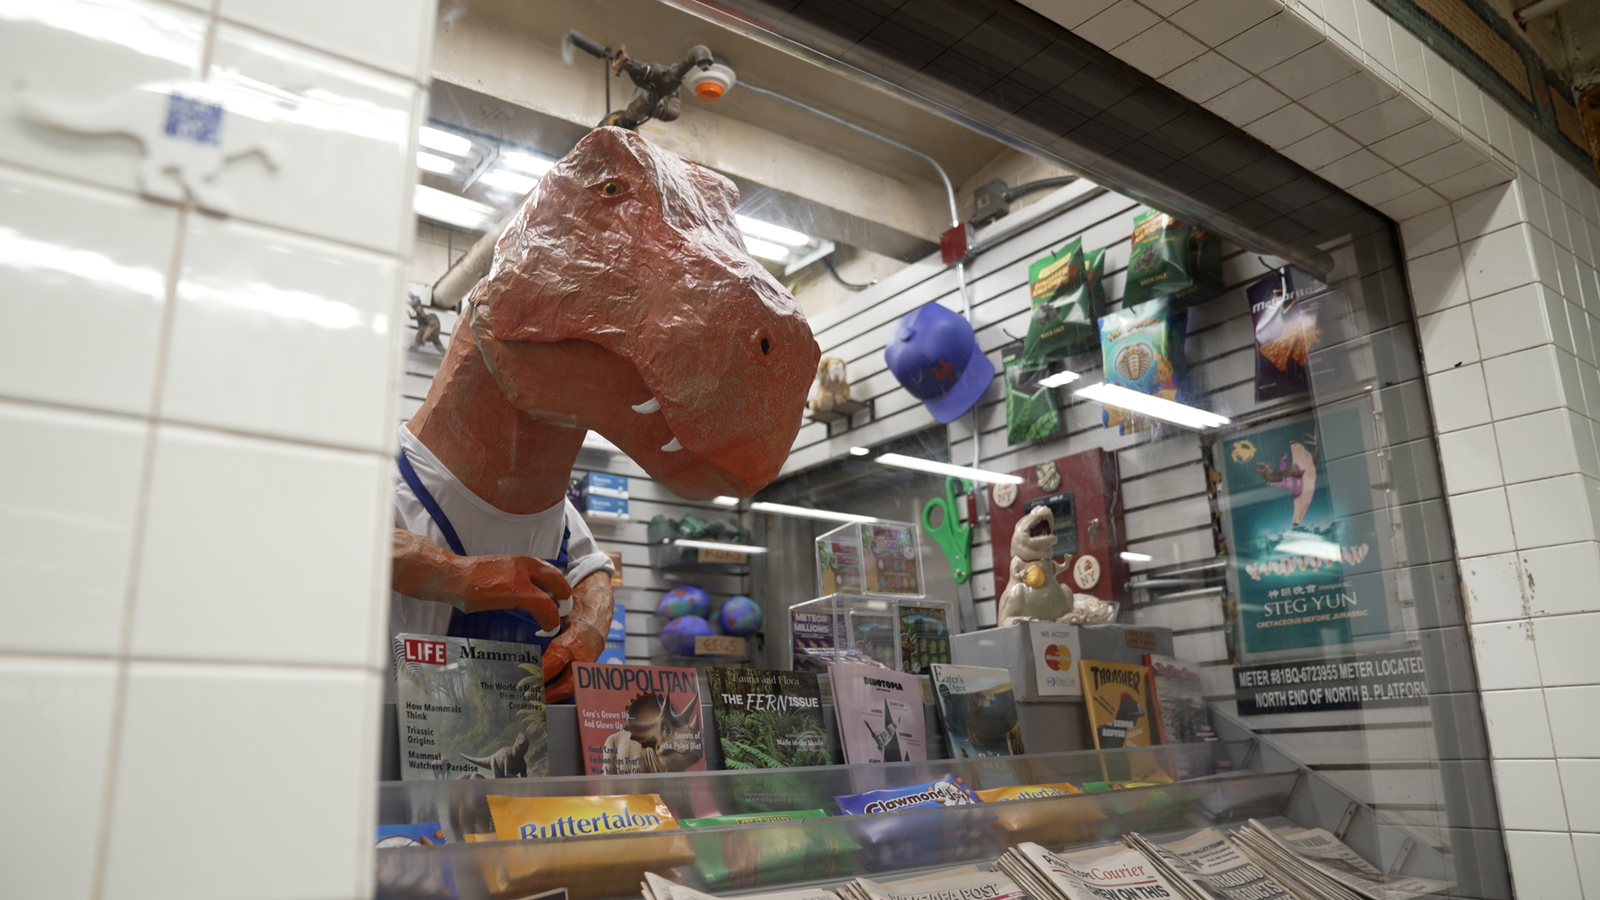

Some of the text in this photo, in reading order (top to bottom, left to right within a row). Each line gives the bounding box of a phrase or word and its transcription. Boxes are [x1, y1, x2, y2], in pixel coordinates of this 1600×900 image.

[997, 491, 1013, 503] NY
[1080, 571, 1096, 587] NY
[1263, 591, 1358, 617] STEG YUN
[794, 613, 828, 623] METEOR
[1256, 609, 1369, 629] CRETACEOUS BEFORE JURASSIC
[794, 623, 830, 633] MILLIONS
[1051, 631, 1070, 639] ACCEPT
[406, 641, 539, 664] LIFE Mammals
[1239, 656, 1425, 687] METER #81BQ-6723955 METER LOCATED
[577, 666, 696, 694] DINOPOLITAN
[732, 674, 800, 686] Fauna and Flora
[863, 676, 904, 691] DINOTOPIA
[1090, 666, 1140, 696] THRASHER
[480, 682, 542, 693] The World's Most
[949, 684, 966, 692] Digest
[500, 692, 542, 701] Remarkable
[1255, 691, 1286, 708] NORTH
[1288, 689, 1308, 706] END
[1309, 688, 1322, 705] OF
[1324, 685, 1358, 703] NORTH
[1361, 684, 1374, 701] B.
[406, 702, 462, 713] How Mammals
[508, 702, 543, 711] Creatures
[721, 693, 819, 712] THE FERN ISSUE
[406, 711, 428, 721] Think
[582, 709, 600, 718] Cera's
[601, 711, 620, 719] Grown
[407, 726, 434, 736] Triassic
[584, 720, 595, 728] And
[614, 721, 624, 730] Up
[674, 731, 701, 740] Secrets of
[1102, 728, 1126, 738] RAPTOR
[407, 735, 435, 747] Origins
[663, 742, 673, 750] the
[408, 751, 442, 761] Mammal
[589, 756, 611, 765] Fashion
[408, 760, 479, 773] Watchers' Paradise
[863, 787, 966, 814] Clawmond Joy
[519, 806, 661, 840] Buttertalon
[1191, 845, 1209, 856] VALLEY
[1091, 864, 1146, 881] Courier
[959, 882, 1001, 900] POST
[1116, 887, 1139, 900] ON
[1135, 884, 1171, 898] THIS
